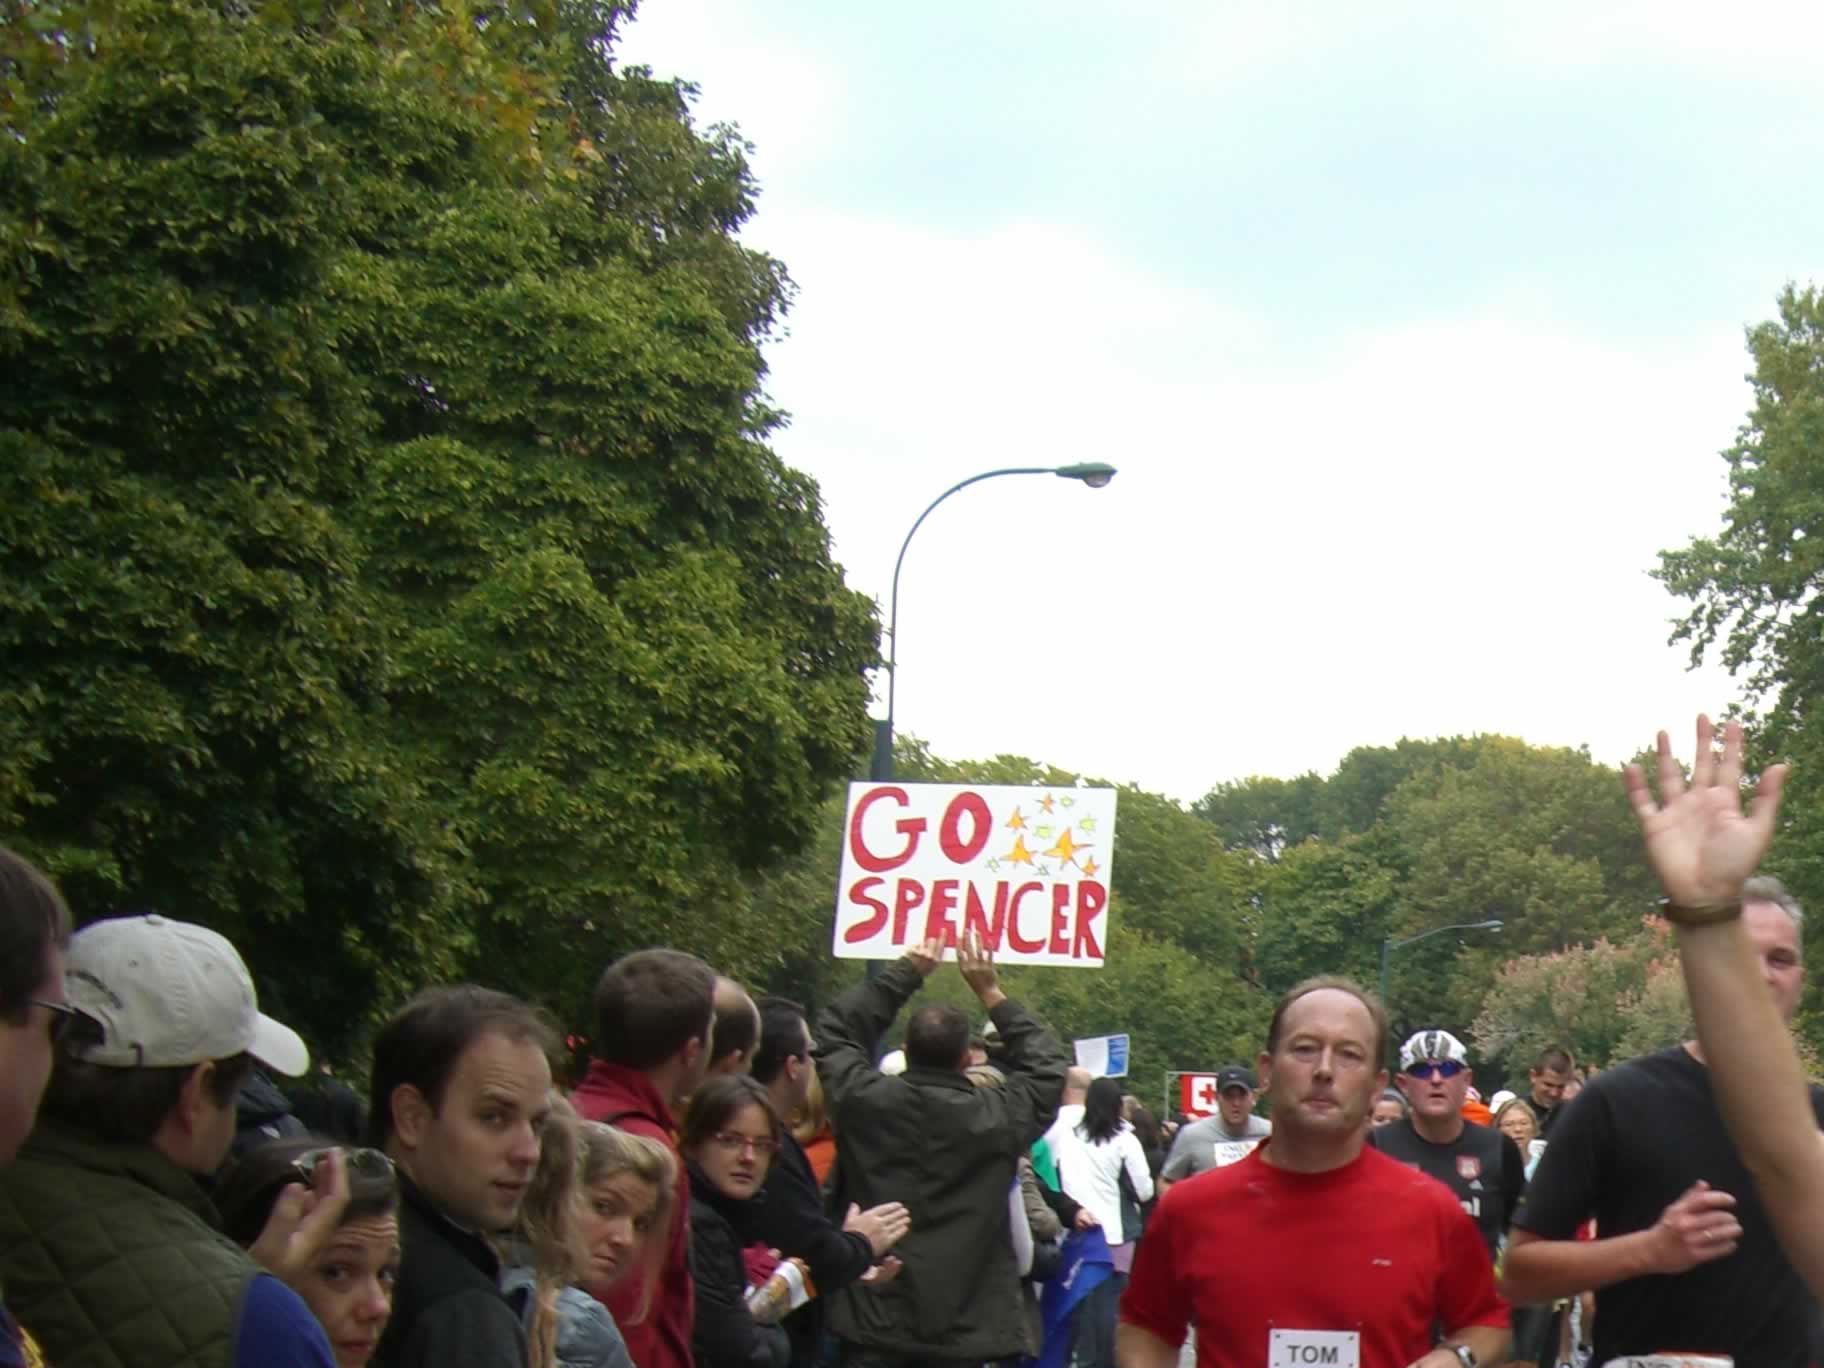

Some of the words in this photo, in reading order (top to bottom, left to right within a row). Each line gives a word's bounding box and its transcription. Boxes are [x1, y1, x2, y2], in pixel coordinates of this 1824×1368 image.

[850, 786, 993, 873] GO
[844, 876, 1106, 959] SPENCER
[1287, 1345, 1339, 1364] TOM
